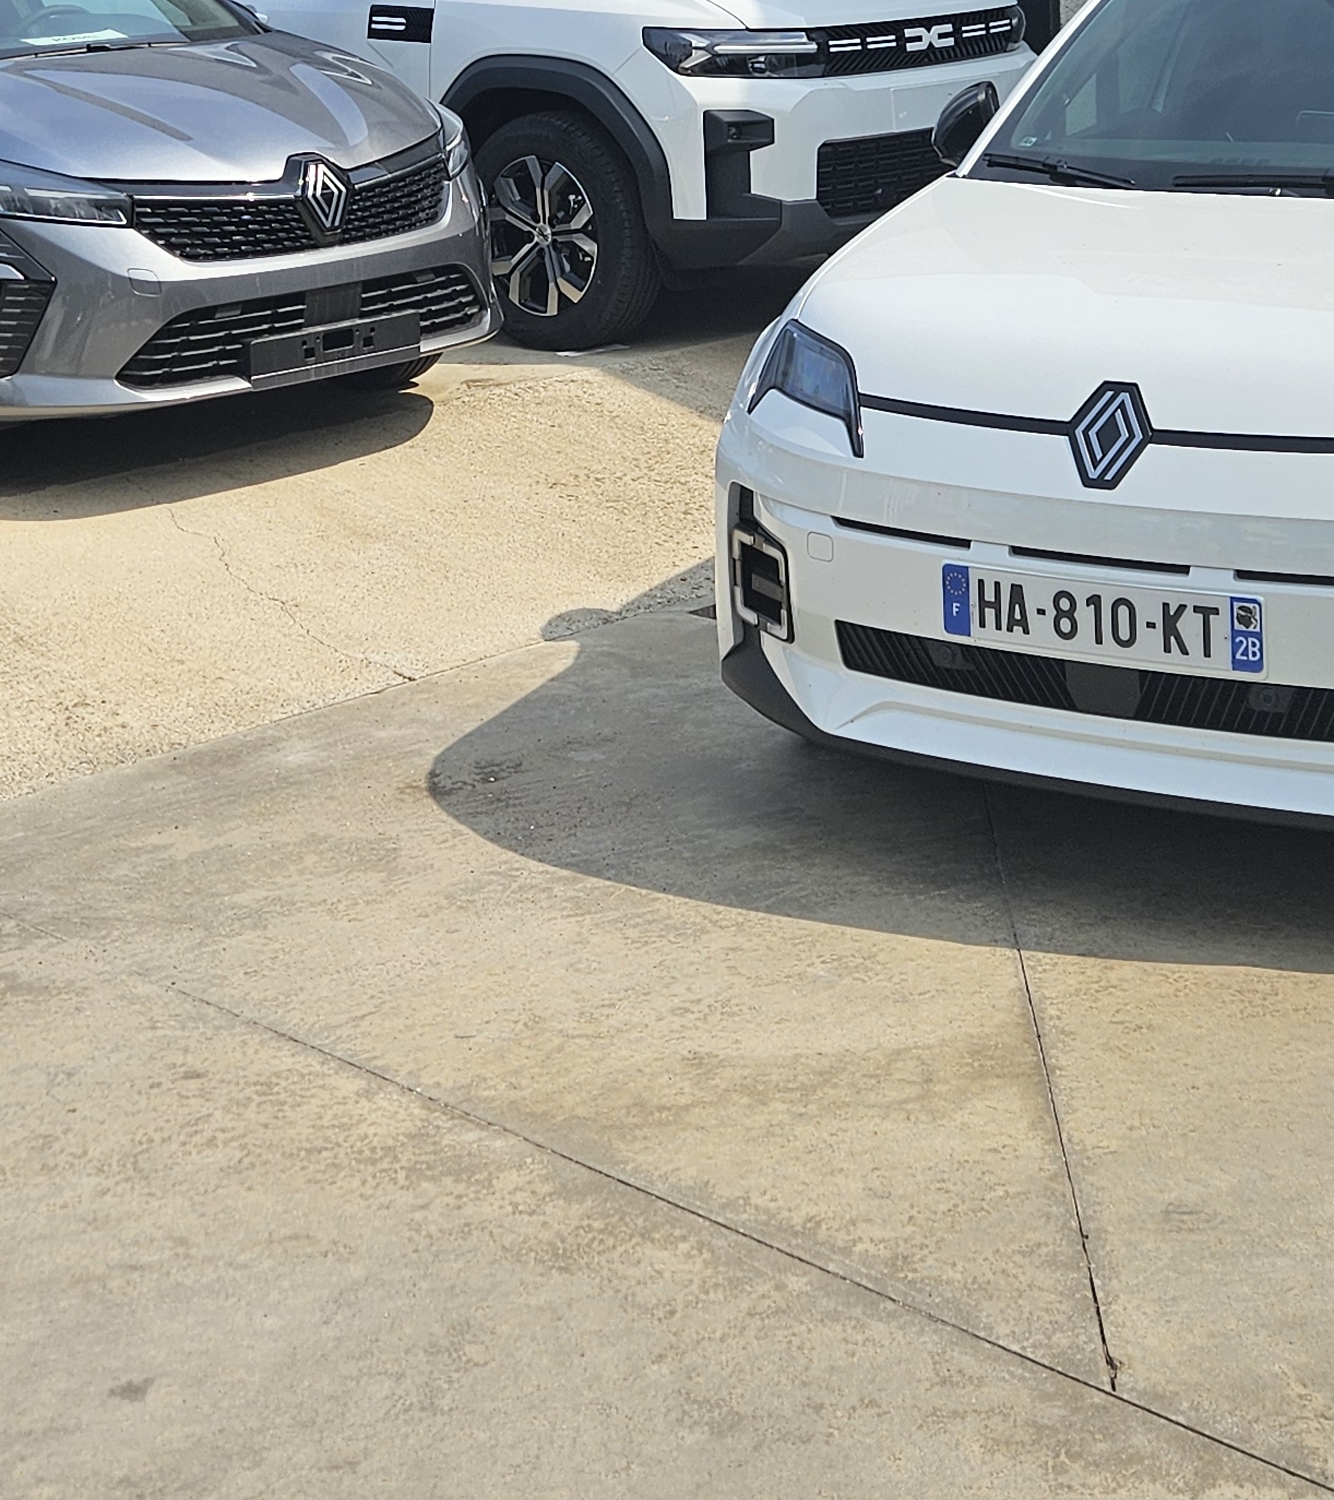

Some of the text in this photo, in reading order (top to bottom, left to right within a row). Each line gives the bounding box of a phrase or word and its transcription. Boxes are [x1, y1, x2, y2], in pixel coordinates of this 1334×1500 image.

[951, 602, 962, 618] F
[977, 578, 1220, 658] HA-810-KT
[1234, 635, 1262, 663] 2B
